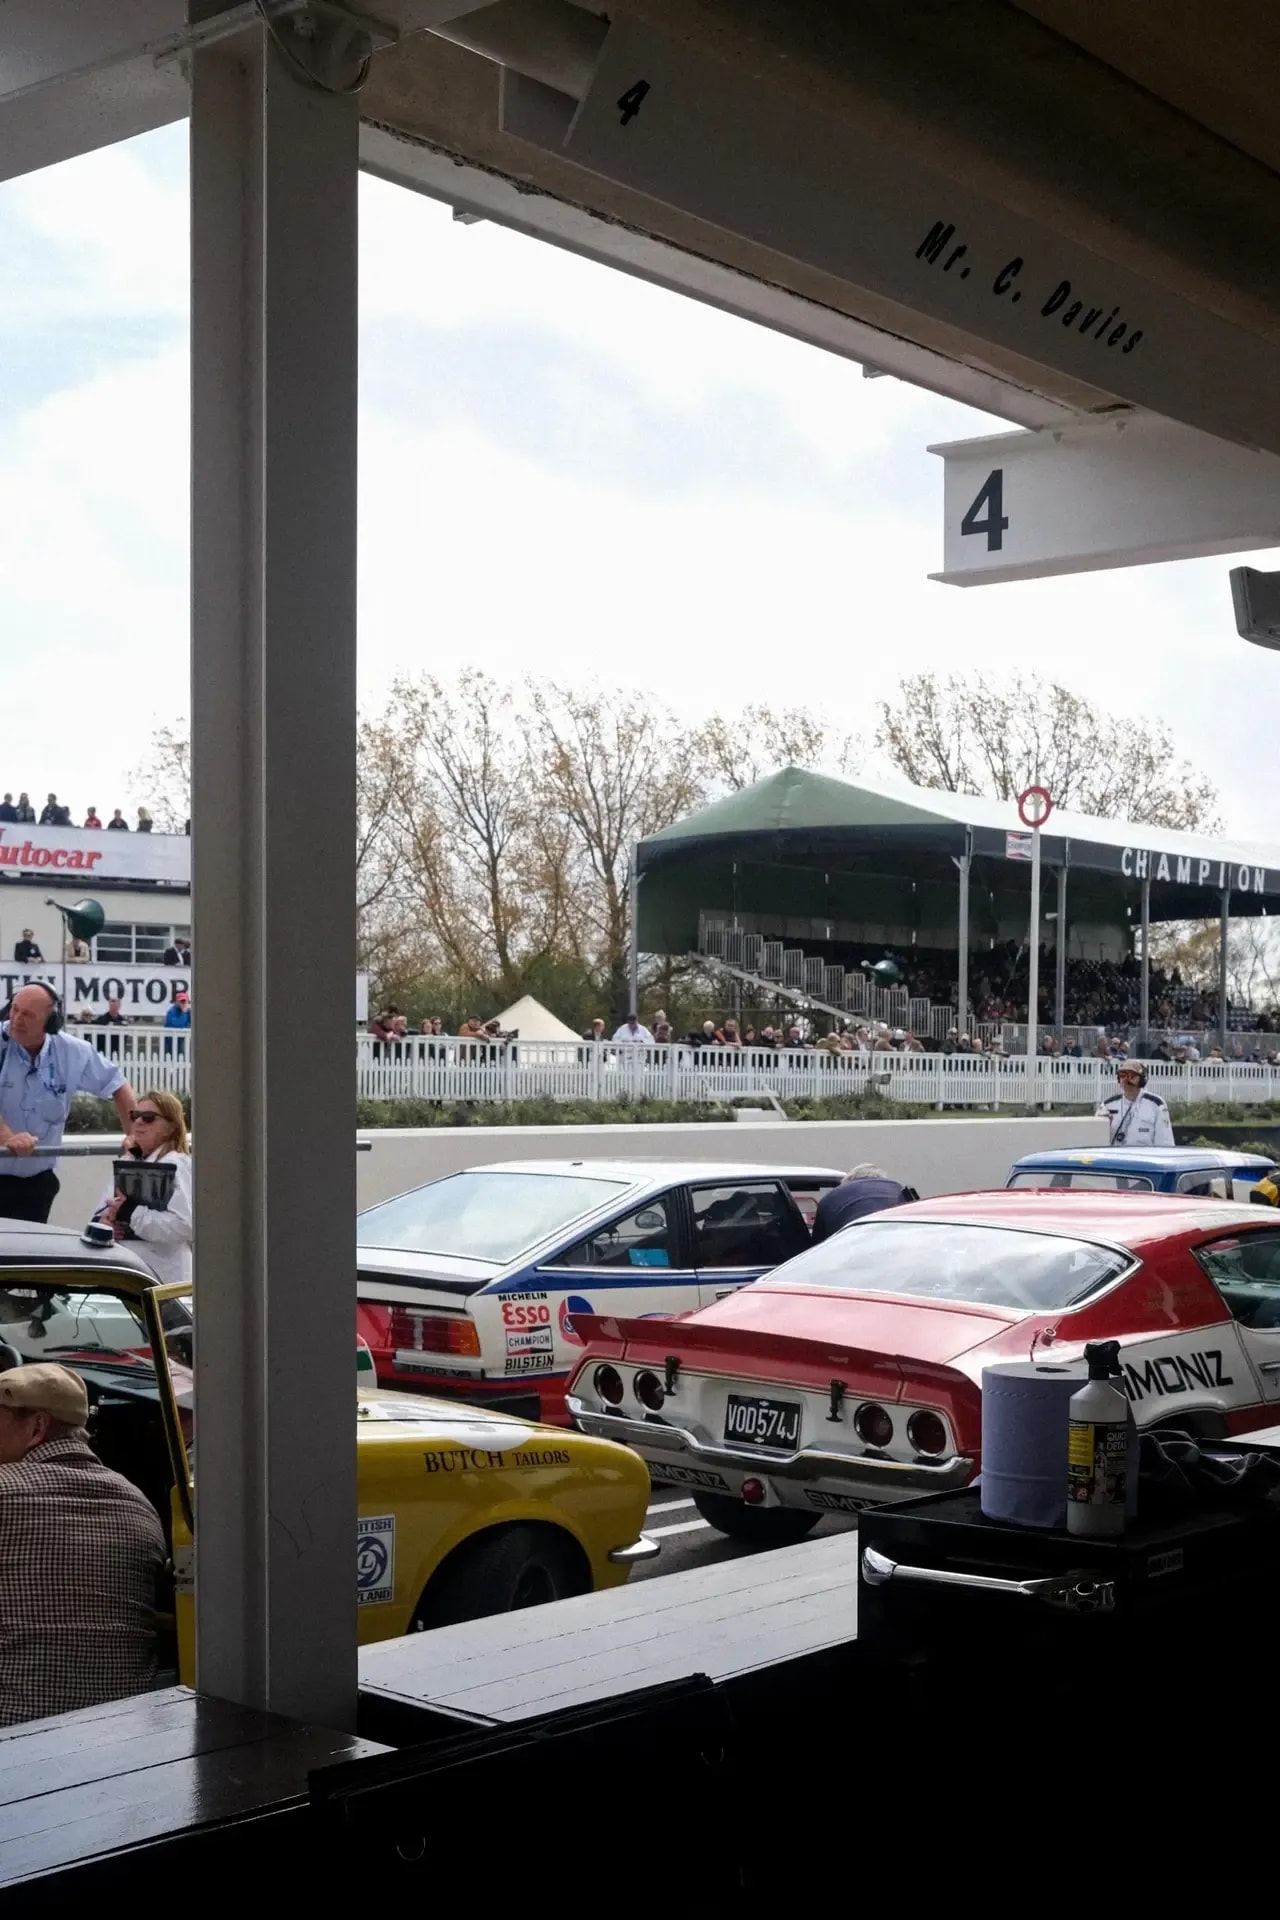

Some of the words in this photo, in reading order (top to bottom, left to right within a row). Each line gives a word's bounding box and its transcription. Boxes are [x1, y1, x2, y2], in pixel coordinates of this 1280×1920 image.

[617, 79, 651, 126] 4
[915, 221, 971, 279] Mr.
[991, 256, 1024, 302] C.
[1040, 279, 1144, 354] Davies
[960, 468, 1009, 552] 4
[0, 828, 103, 870] utocar
[1120, 847, 1266, 894] CHAMPION
[498, 1292, 548, 1302] MICHELIN
[508, 1335, 550, 1347] CHAMPION
[402, 1364, 447, 1377] 500
[504, 1354, 555, 1371] BILSTEIN
[727, 1403, 799, 1440] VOD574J
[423, 1448, 505, 1473] BUTCH
[511, 1449, 571, 1466] TAILORS
[648, 1462, 728, 1488] IMONIZ
[358, 1520, 392, 1533] ITISH
